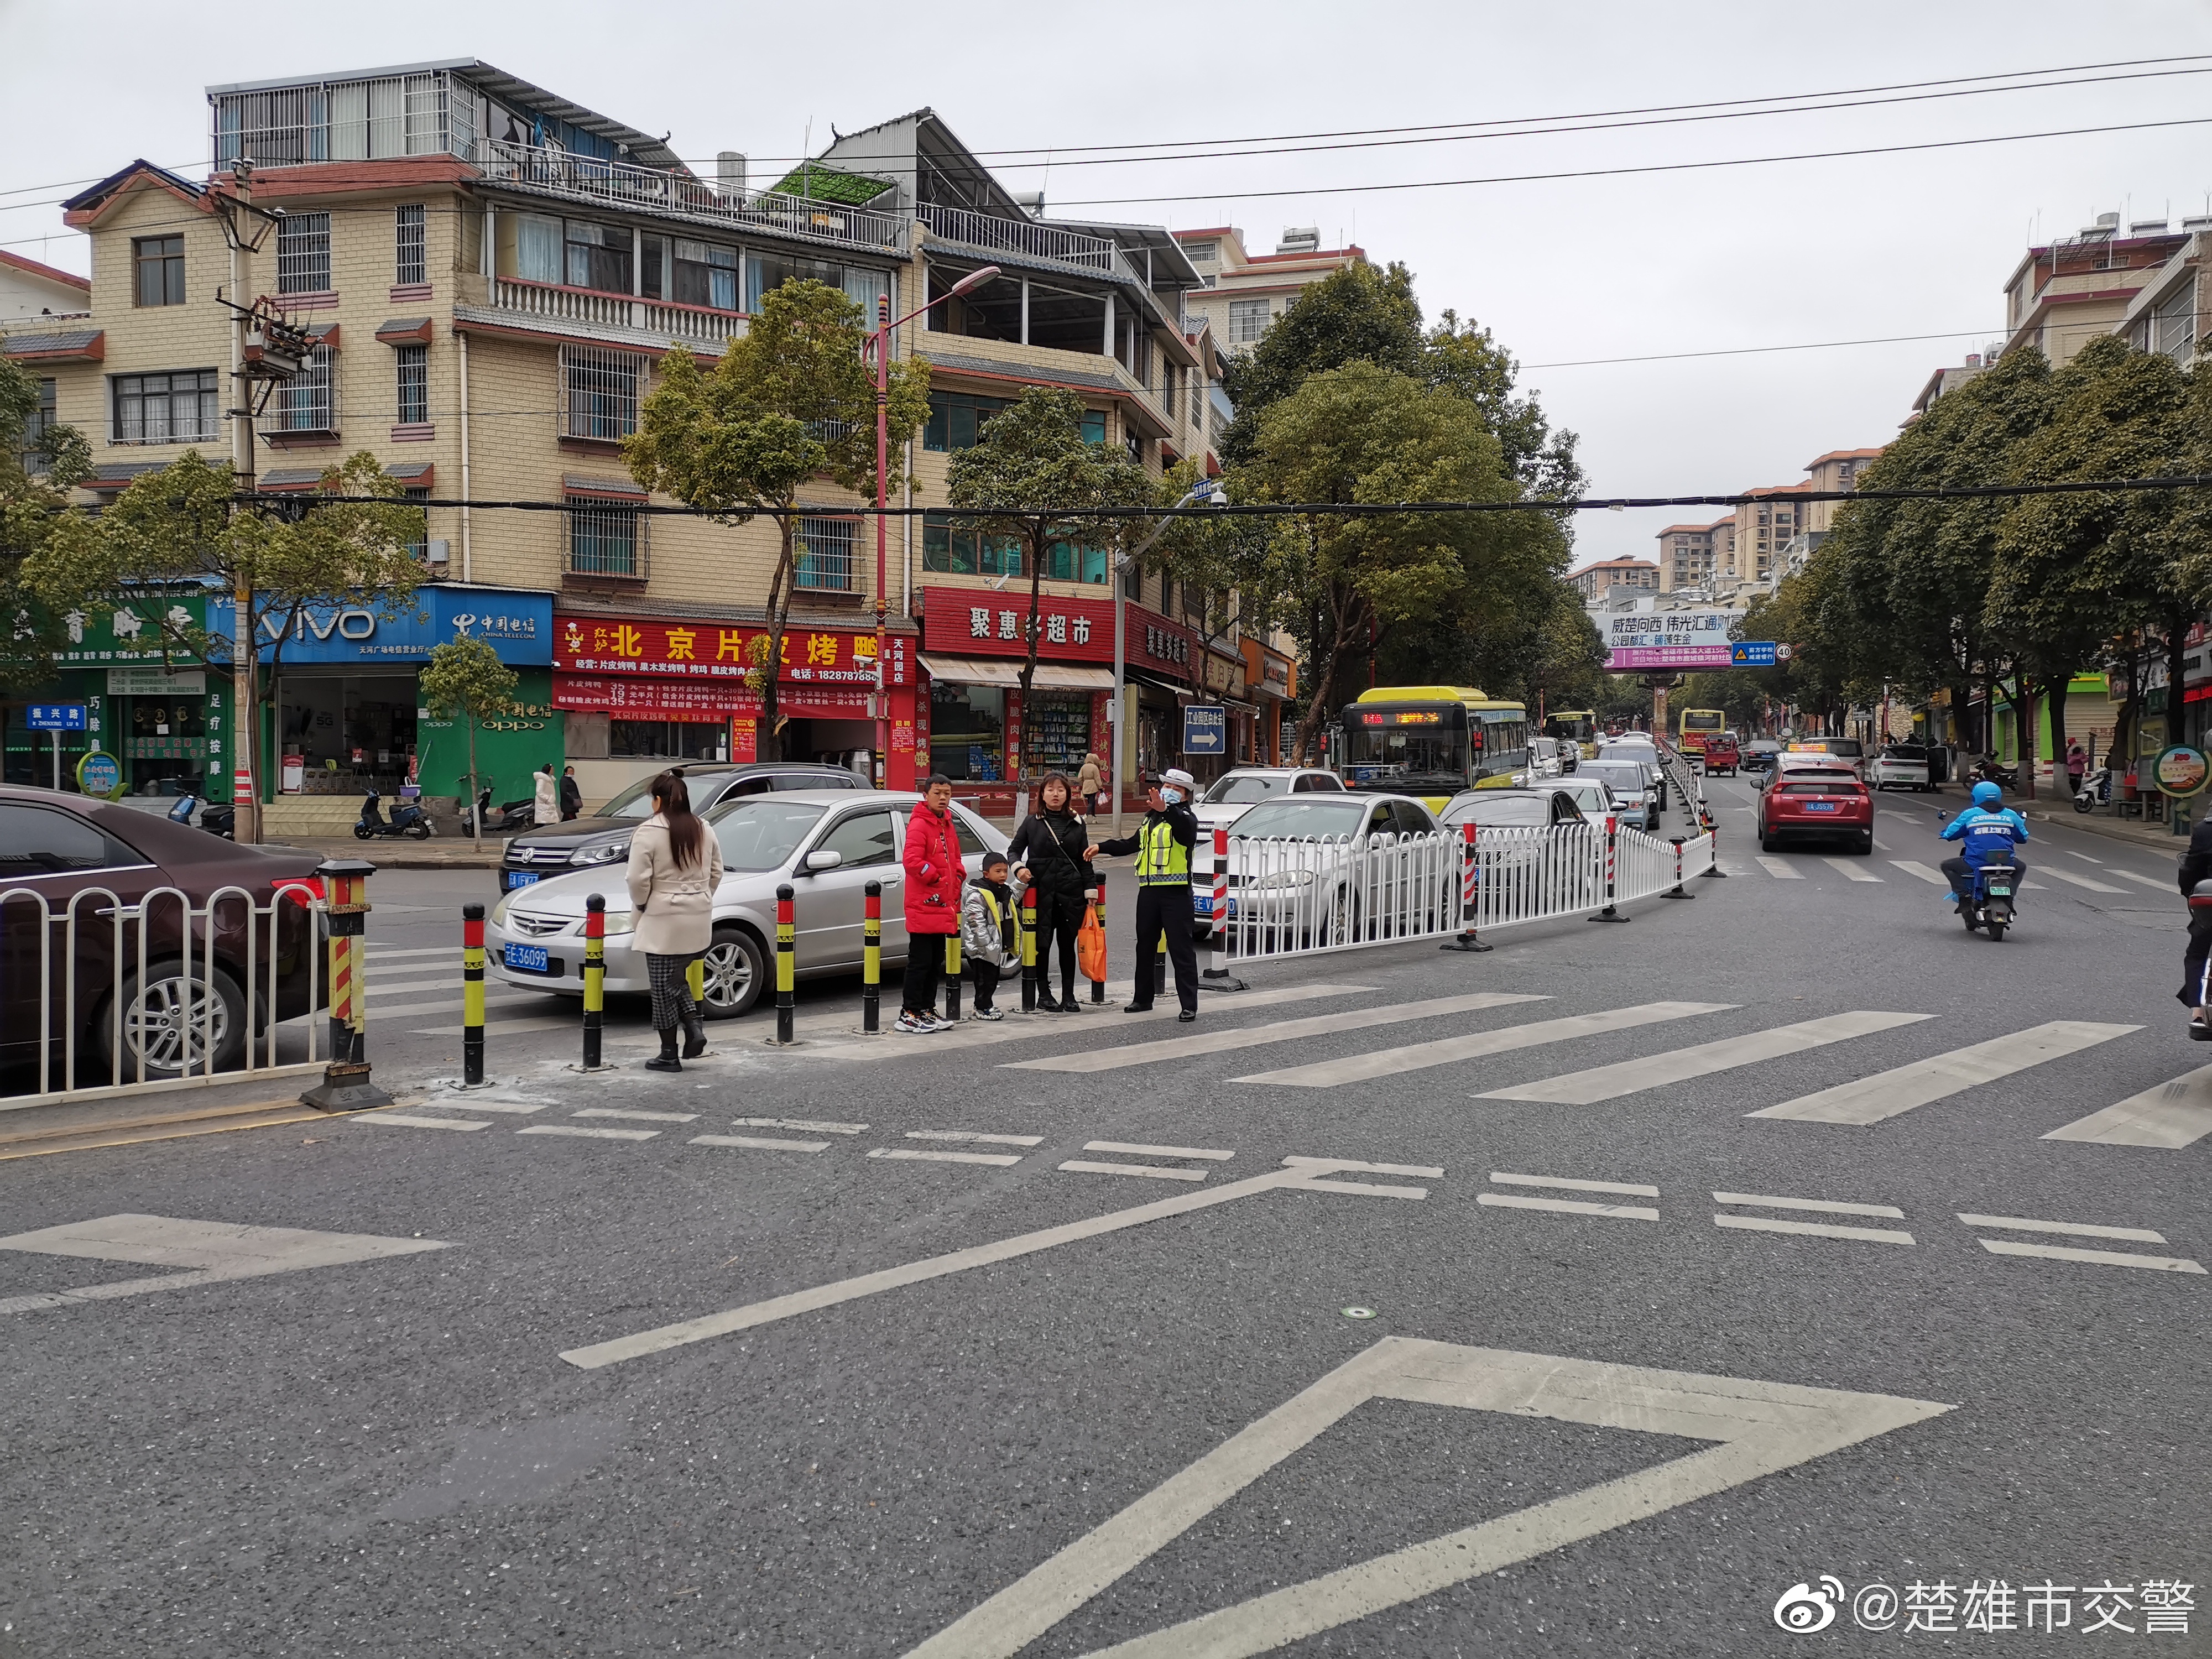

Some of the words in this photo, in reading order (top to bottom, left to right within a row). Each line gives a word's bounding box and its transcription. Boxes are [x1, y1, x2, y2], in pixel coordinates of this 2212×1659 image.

[262, 605, 375, 639] vivo
[481, 614, 535, 632] 中国电信
[1612, 617, 1663, 633] 威楚向西
[594, 627, 607, 652] 红炉
[359, 645, 425, 654] 天河广场电信营业厅
[640, 662, 686, 673] 果木炭烤鸭
[690, 664, 707, 674] 烤鸡
[894, 639, 904, 682] 天河园店
[610, 697, 625, 706] 35
[33, 708, 79, 719] 振兴路
[917, 683, 927, 749] 现杀现烤
[1010, 690, 1020, 753] 皮脆肉甜
[1187, 712, 1223, 726] 工业园区由此去
[210, 694, 221, 775] 足疗按摩
